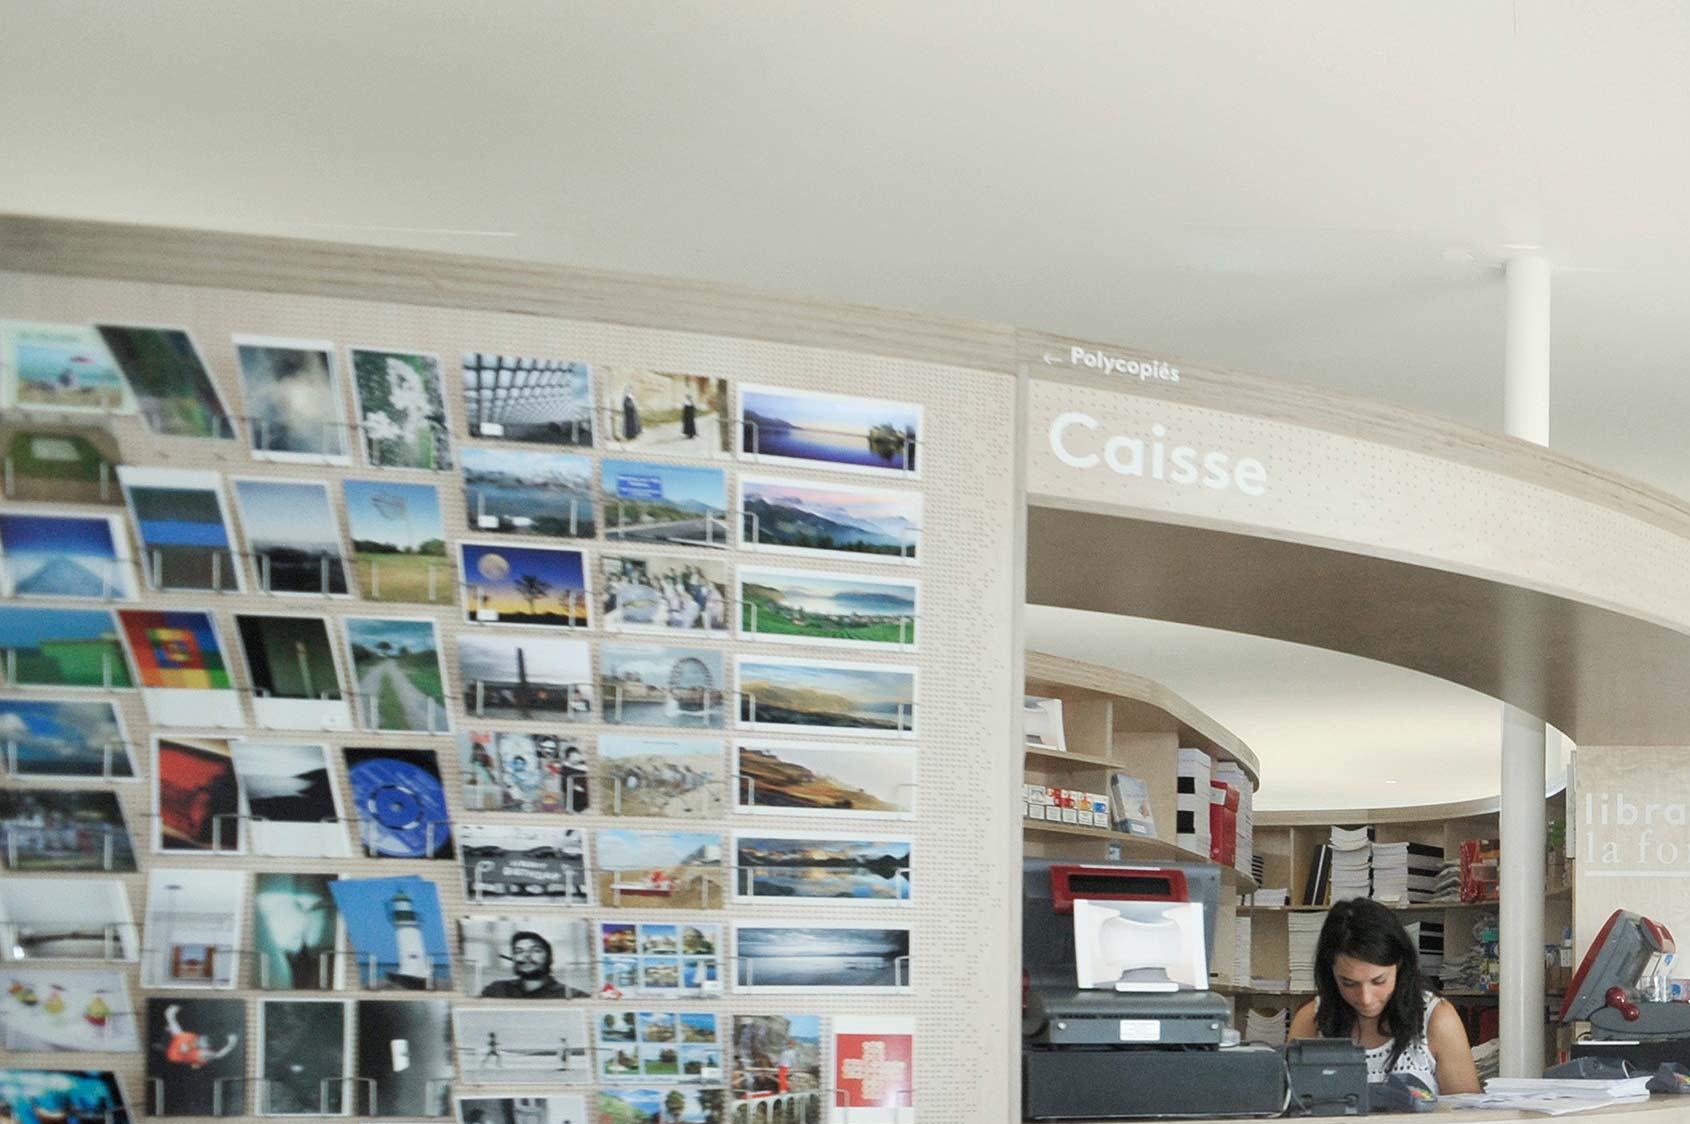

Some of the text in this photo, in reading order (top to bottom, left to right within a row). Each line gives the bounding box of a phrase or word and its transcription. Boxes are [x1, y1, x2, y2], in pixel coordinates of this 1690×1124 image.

[1071, 346, 1181, 383] Polycopiés
[1050, 411, 1267, 496] Caisse
[1586, 832, 1622, 864] la
